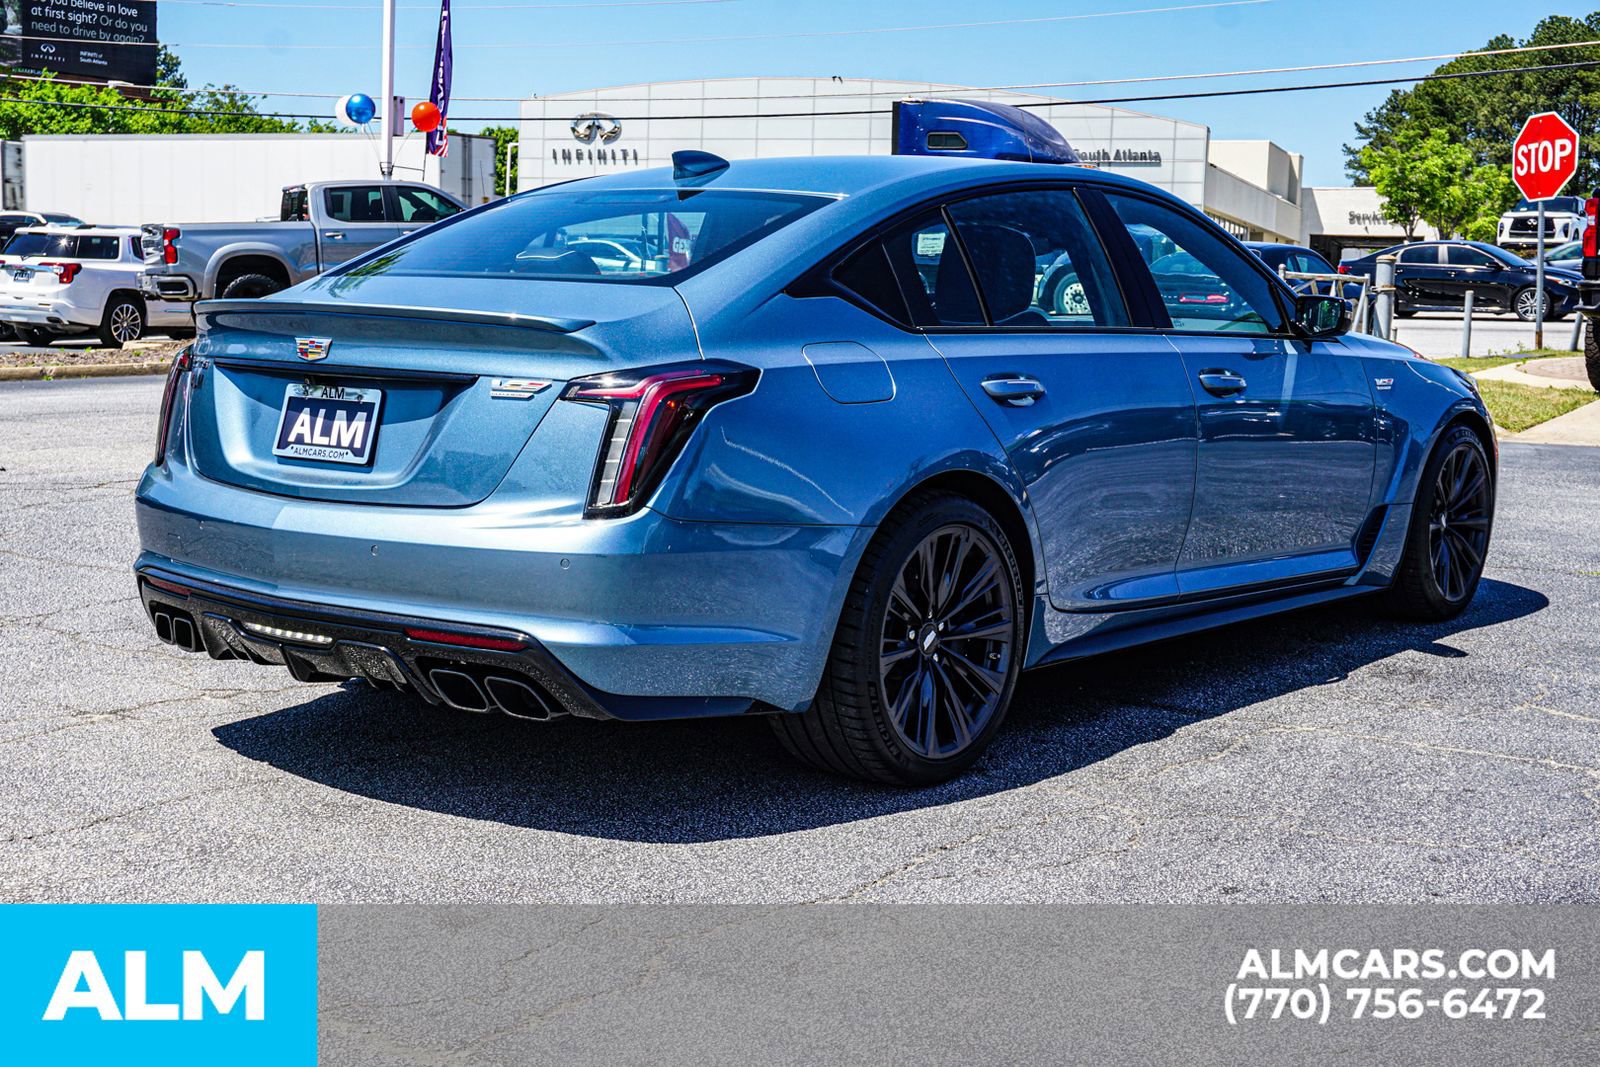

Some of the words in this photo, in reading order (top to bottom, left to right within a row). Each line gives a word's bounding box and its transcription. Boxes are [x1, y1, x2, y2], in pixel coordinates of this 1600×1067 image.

[70, 0, 105, 12] believe
[107, 2, 116, 14] in
[118, 4, 138, 17] love
[31, 6, 42, 17] at
[45, 6, 66, 20] first
[67, 11, 98, 24] sight?
[100, 15, 113, 26] Or
[115, 18, 128, 29] do
[130, 22, 148, 32] you
[31, 21, 57, 33] need
[59, 24, 70, 34] to
[72, 26, 97, 38] drive
[99, 29, 111, 41] by
[113, 33, 145, 44] again?
[30, 53, 66, 62] INFINITI
[552, 148, 639, 165] INFINITI
[1113, 148, 1162, 161] Atlanta
[1516, 138, 1572, 176] STOP
[321, 386, 345, 399] ALM
[287, 407, 367, 449] ALM
